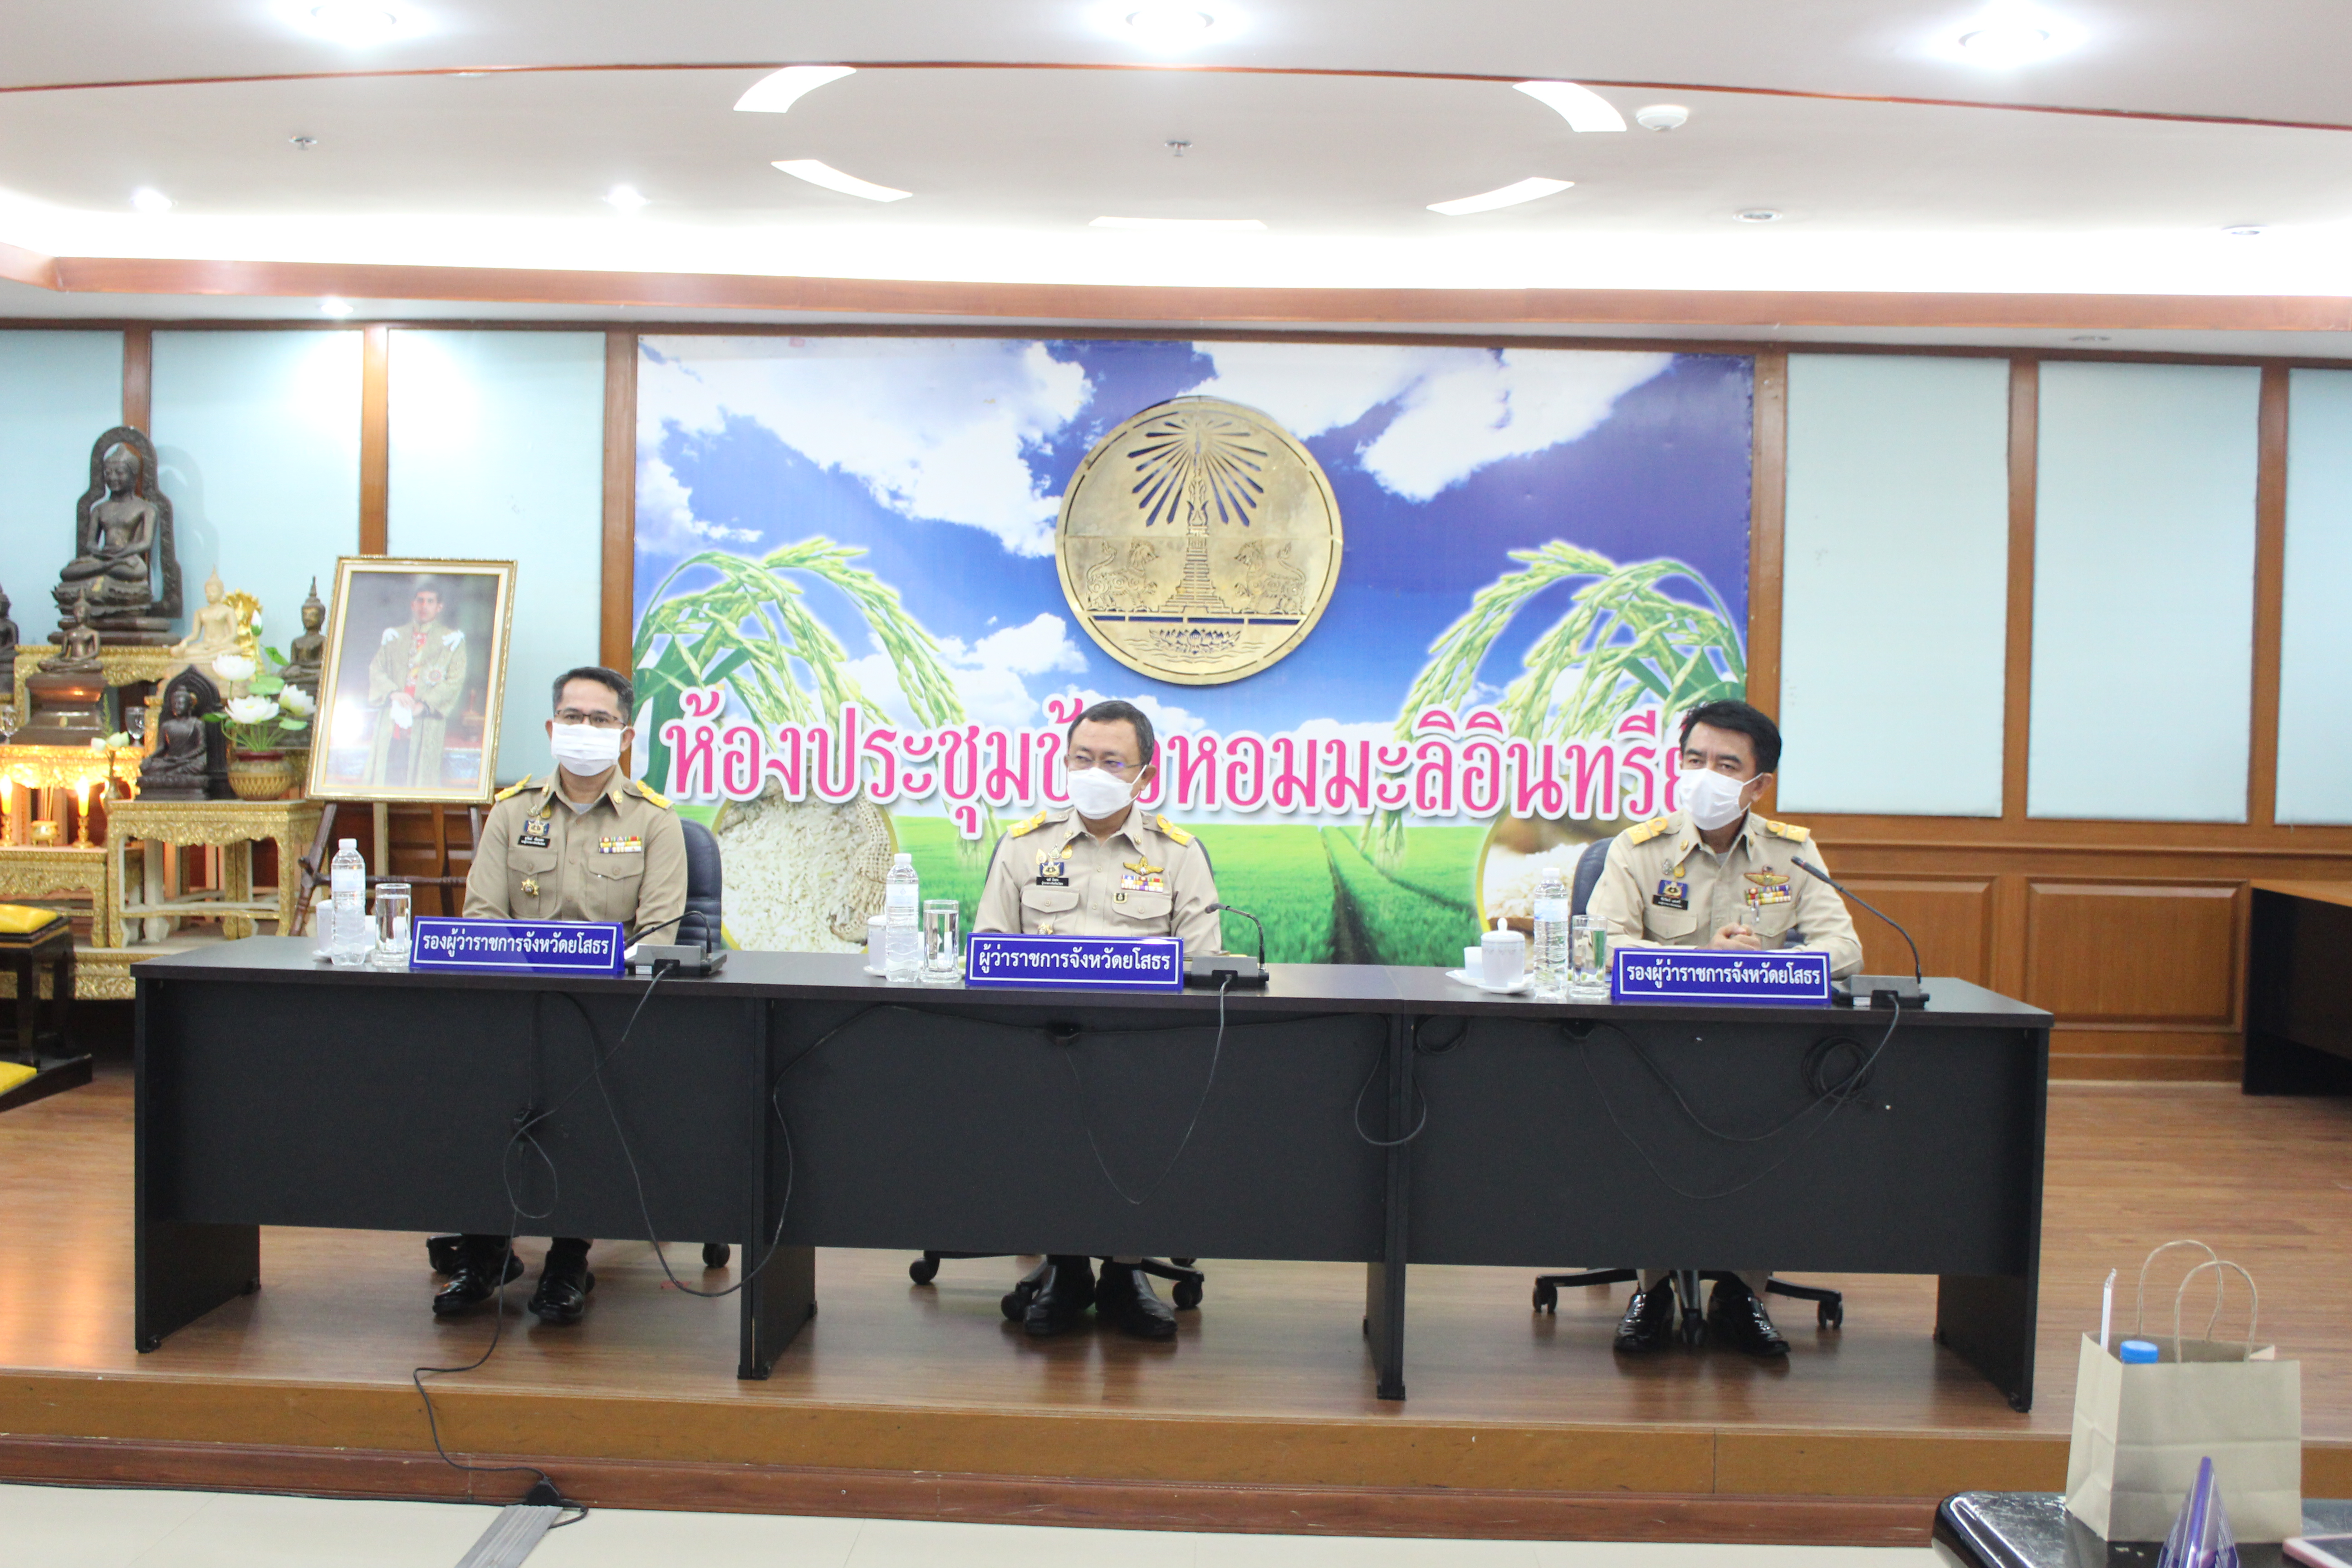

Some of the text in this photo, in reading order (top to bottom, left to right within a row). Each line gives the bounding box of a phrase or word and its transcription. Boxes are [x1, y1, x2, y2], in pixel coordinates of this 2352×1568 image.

[664, 691, 1683, 835] ห้องประชุมข้วหอมมะลิอินทรี
[422, 928, 609, 957] รองผู้ว่าราชการจังหวัดยโสธร
[979, 943, 1171, 974] ผู้ว่าราชการจังหวัดยโสธร
[1626, 958, 1821, 989] รองผู้ว่าราชการจังหวัดยโสธร
